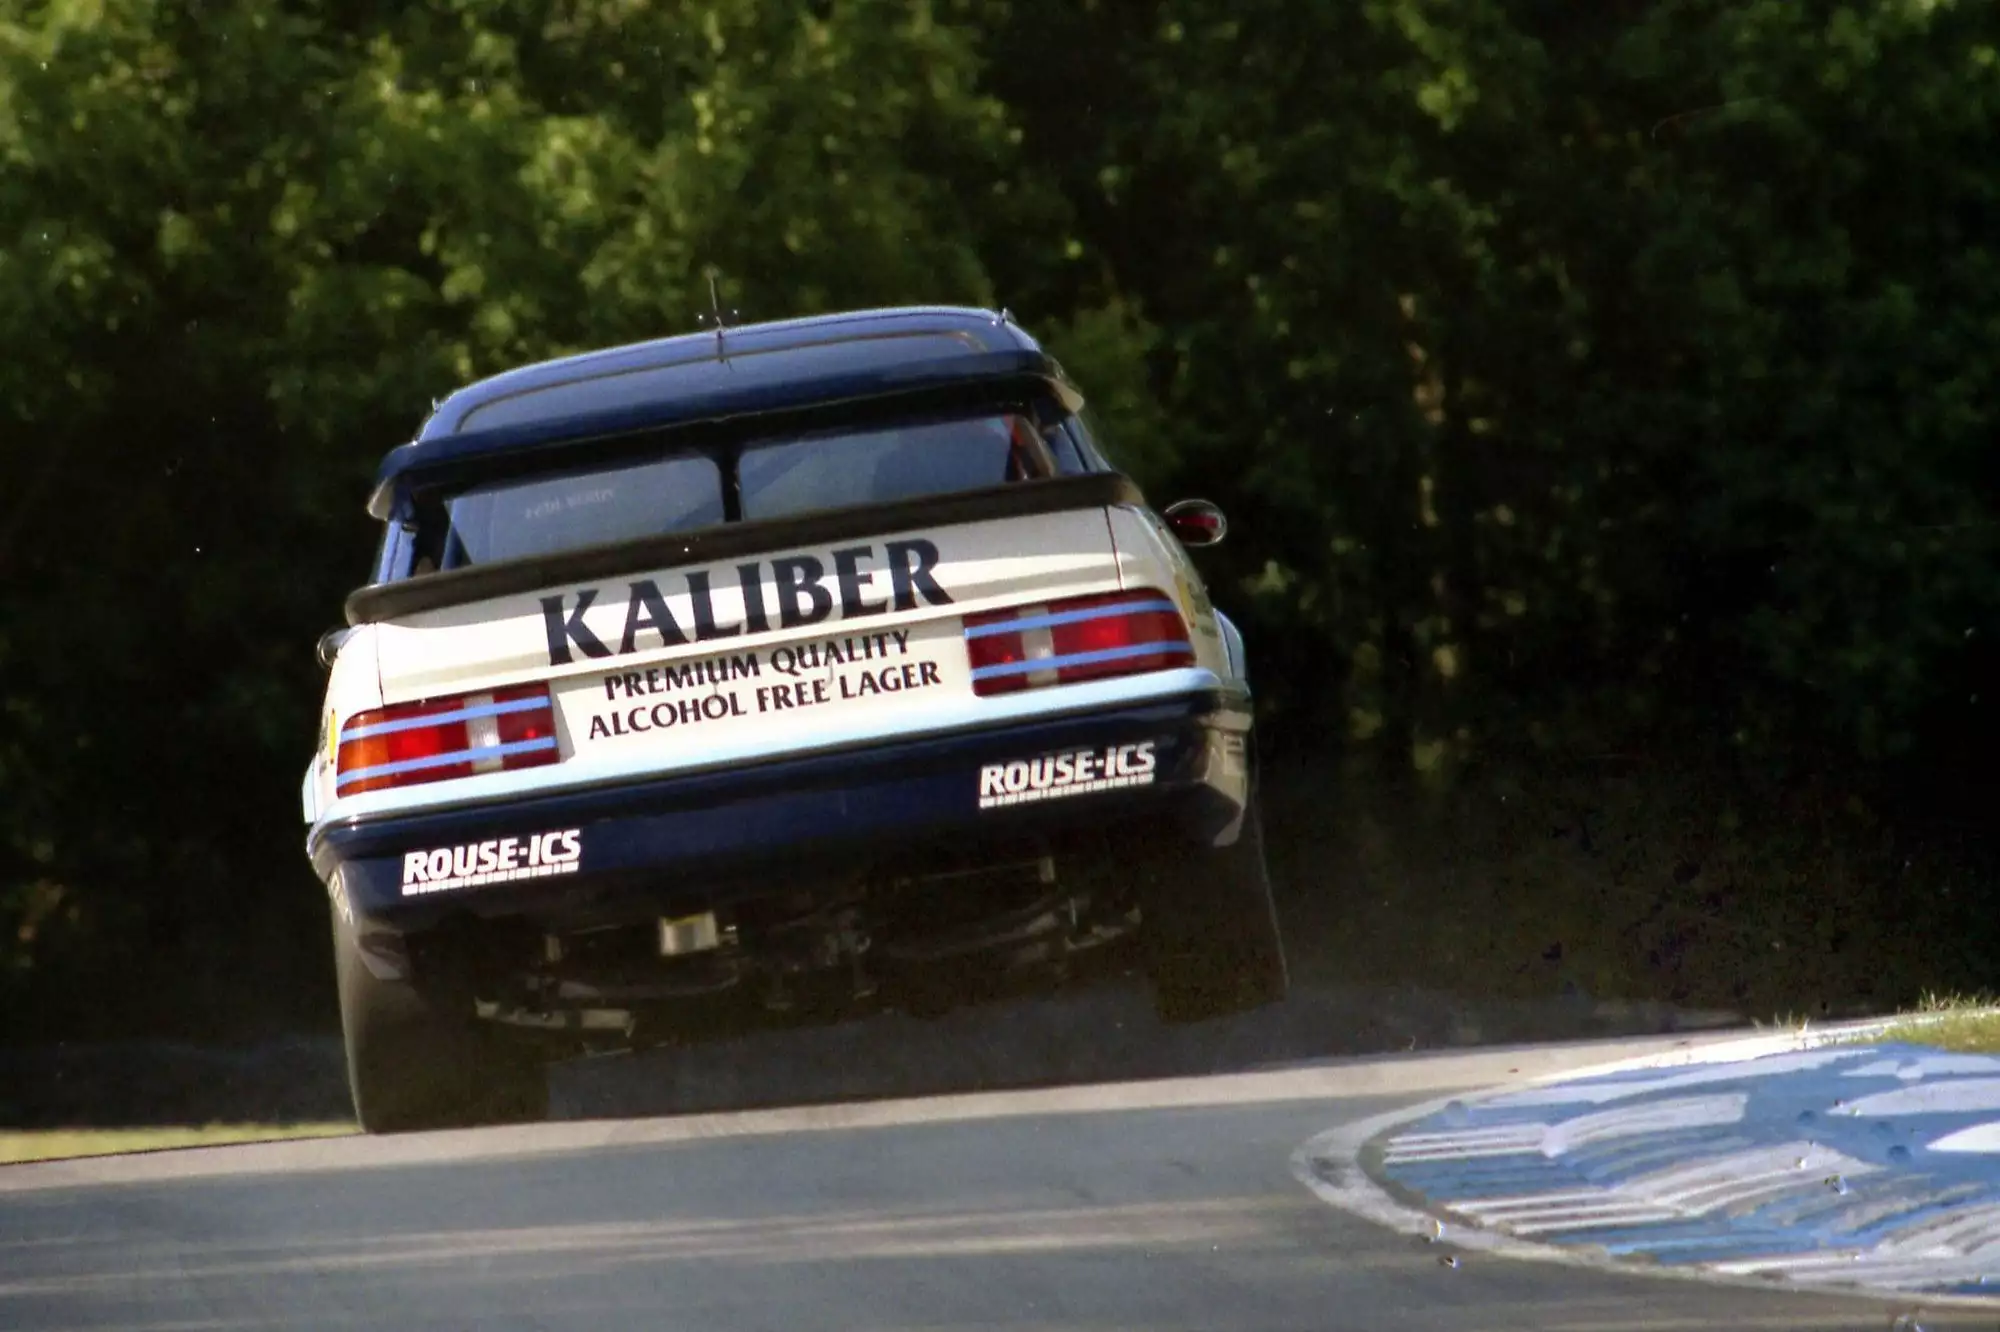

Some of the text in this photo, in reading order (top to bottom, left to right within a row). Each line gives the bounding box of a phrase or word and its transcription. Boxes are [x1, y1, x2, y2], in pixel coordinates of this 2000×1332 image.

[539, 537, 955, 665] KALIBER
[589, 660, 942, 740] ALCOHOL FREE LAGER
[604, 629, 911, 701] PREMIUM QUALITY
[979, 741, 1156, 797] ROUSE-ICS
[403, 829, 581, 885] ROUSE-ICS
